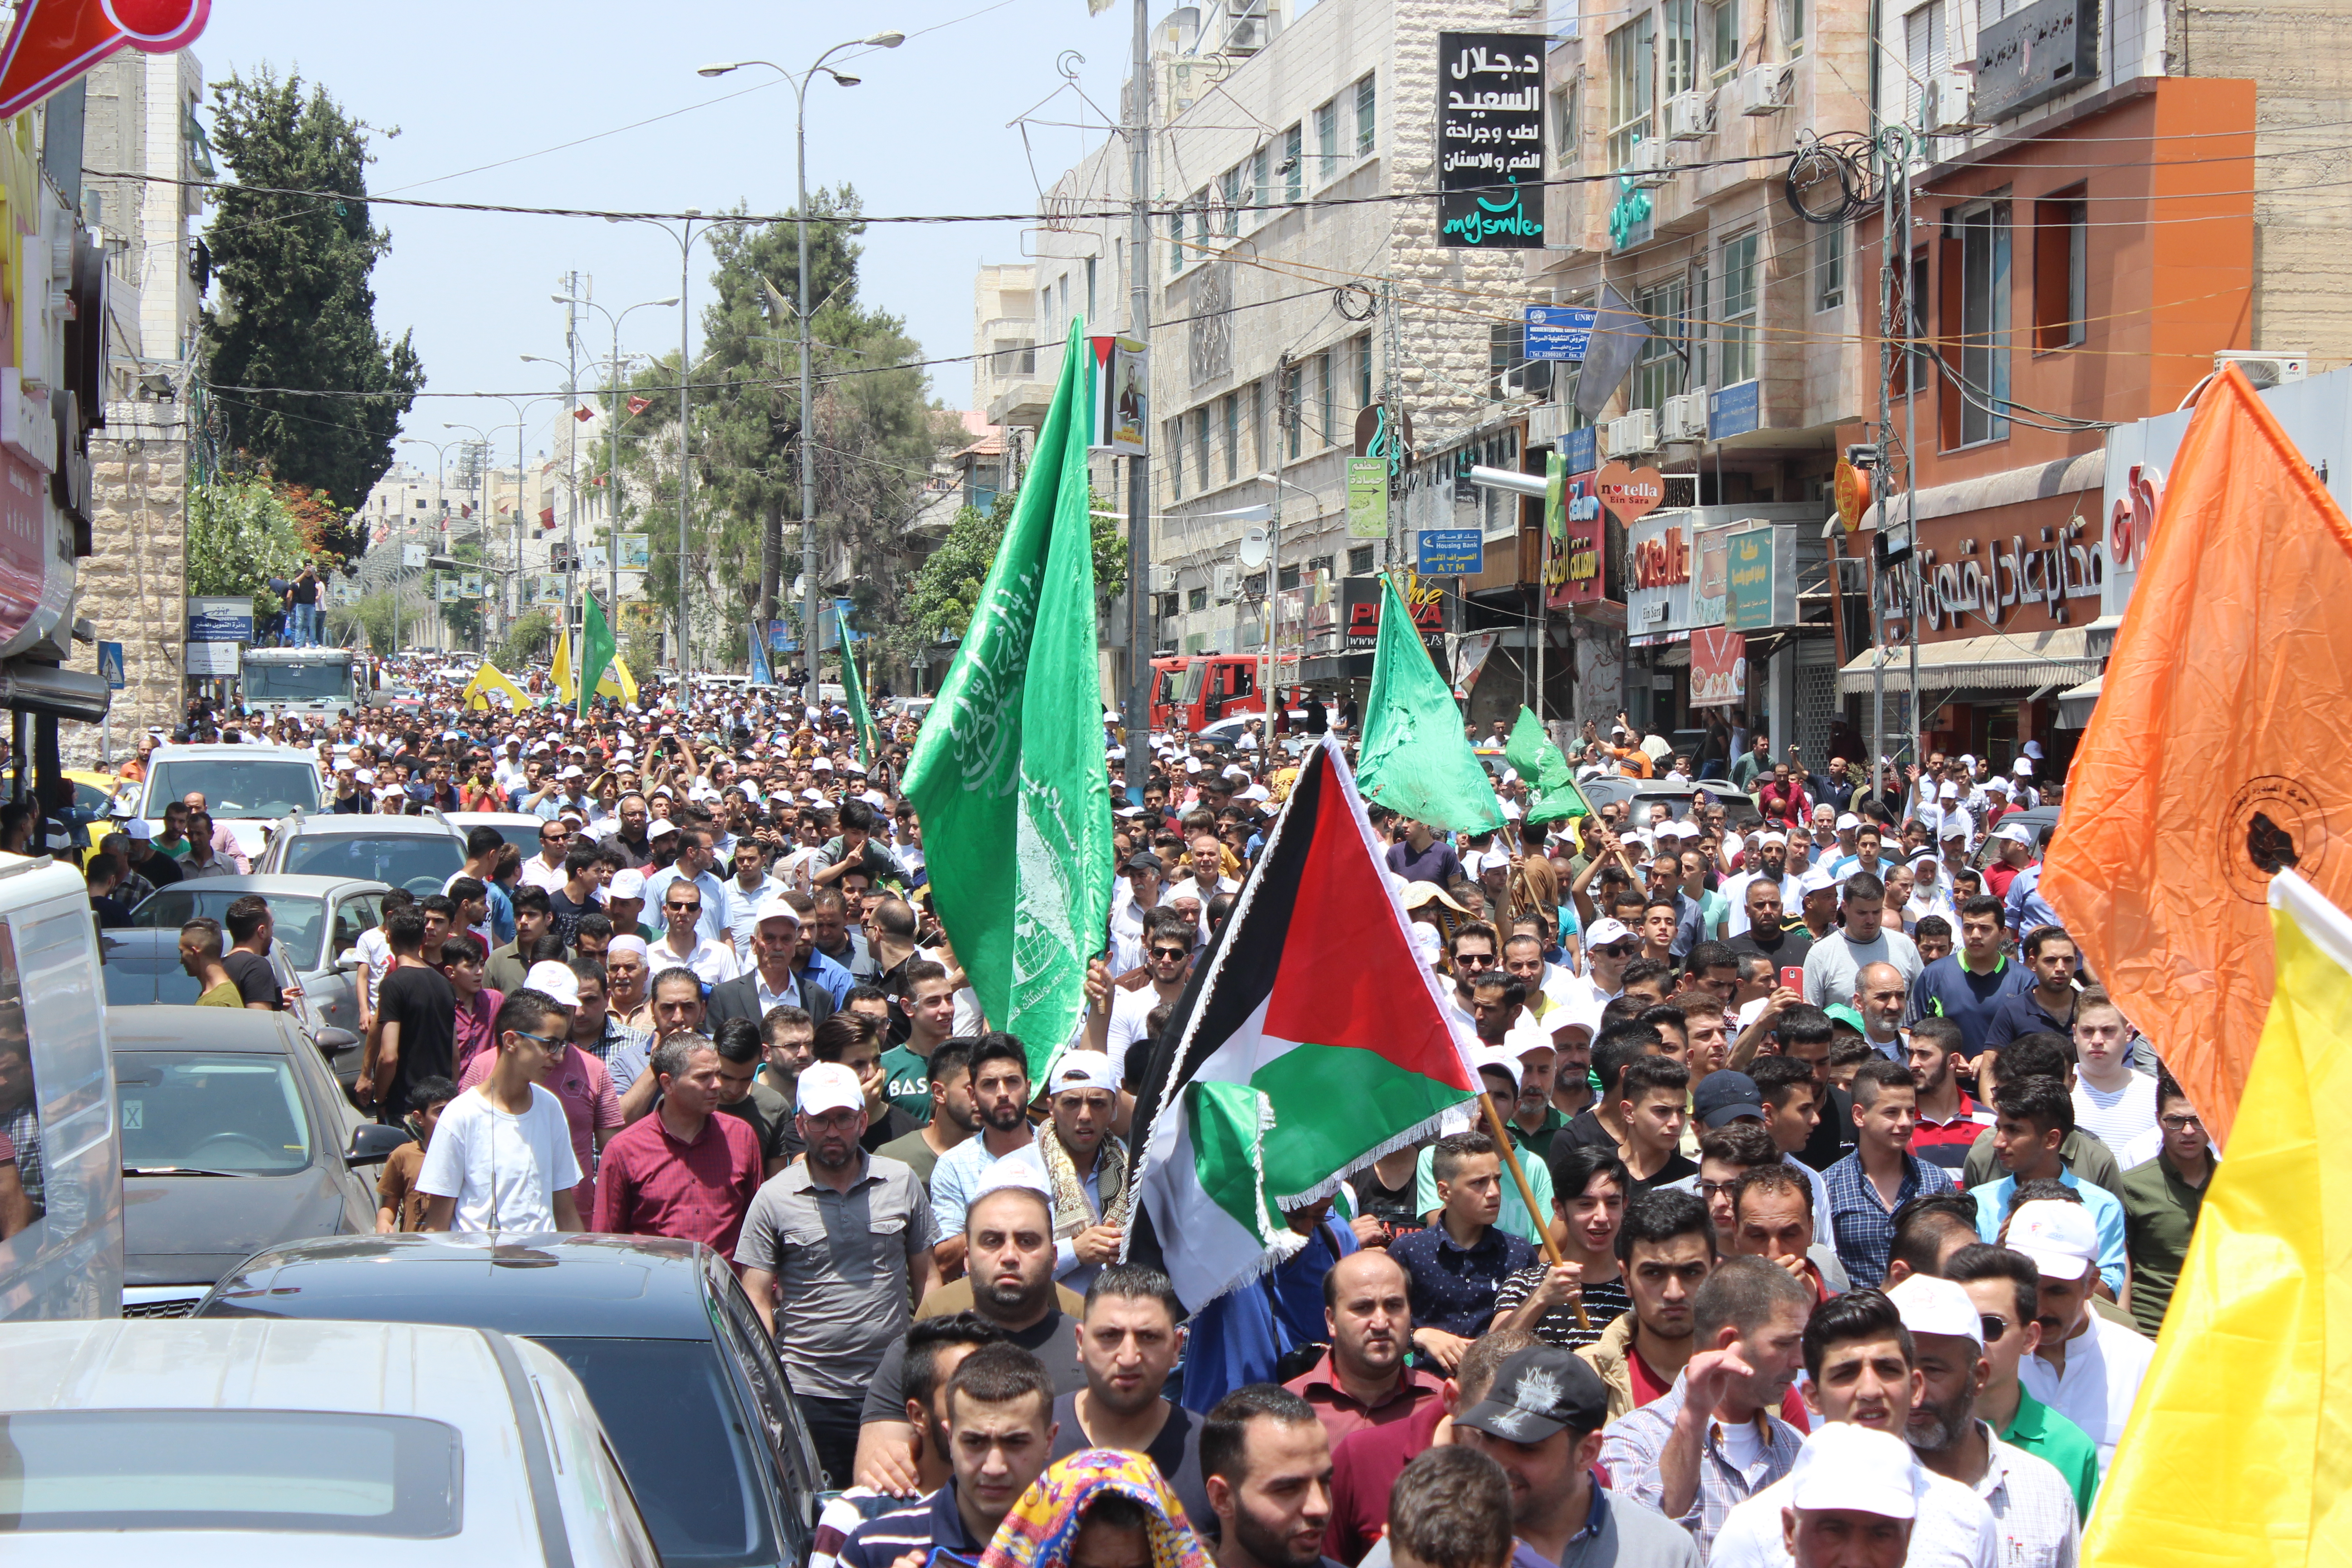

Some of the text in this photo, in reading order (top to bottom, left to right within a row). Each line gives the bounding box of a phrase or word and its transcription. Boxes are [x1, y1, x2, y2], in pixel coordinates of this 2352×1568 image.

[1451, 47, 1539, 81] د.جلال
[1448, 86, 1539, 118] السعيد
[1446, 119, 1539, 146] لطب وجراحة
[1506, 150, 1540, 173] الفم
[1351, 460, 1382, 473] مطعم
[1350, 475, 1385, 485] حمادة
[1981, 535, 2045, 625] عادل
[1350, 603, 1443, 624] PIZA
[1651, 604, 1661, 618] Sara
[1526, 1390, 1547, 1403] SPORTS
